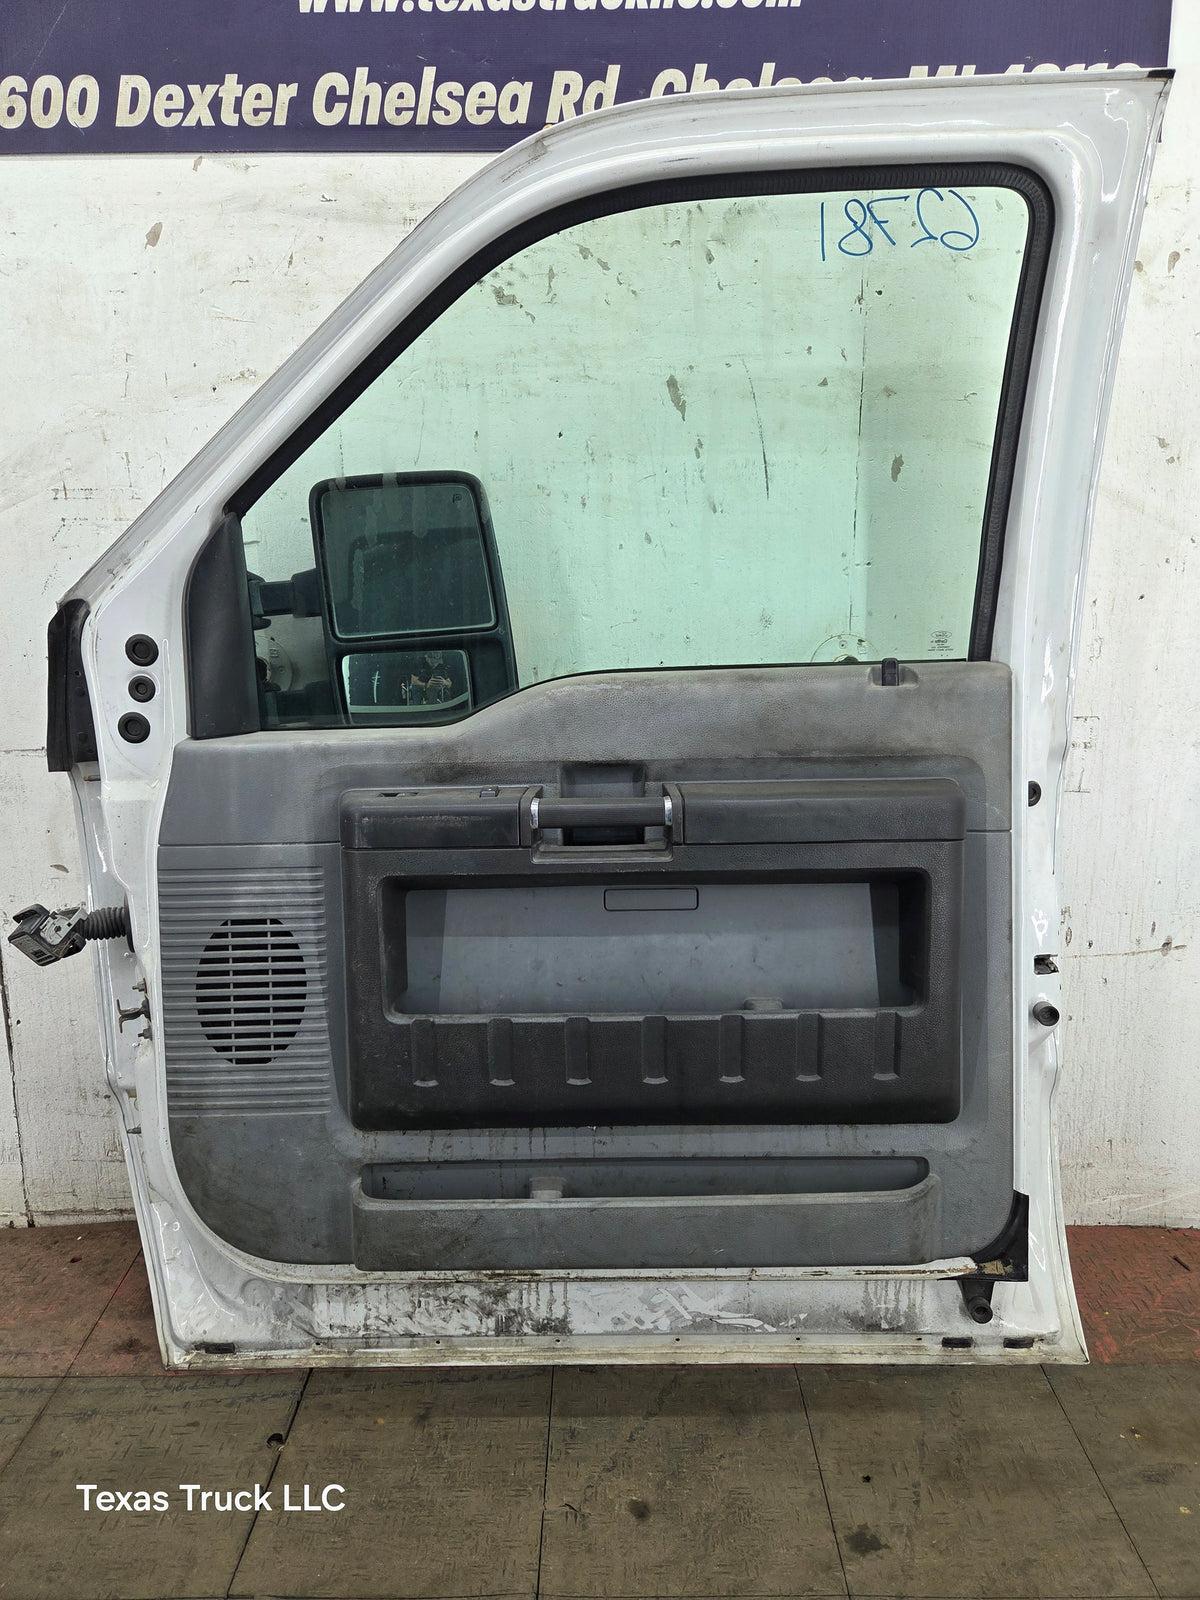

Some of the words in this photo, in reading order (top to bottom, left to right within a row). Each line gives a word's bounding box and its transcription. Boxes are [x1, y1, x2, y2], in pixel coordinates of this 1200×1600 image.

[0, 74, 100, 130] 600
[115, 73, 299, 128] Dexter
[312, 66, 533, 127] Chelsea
